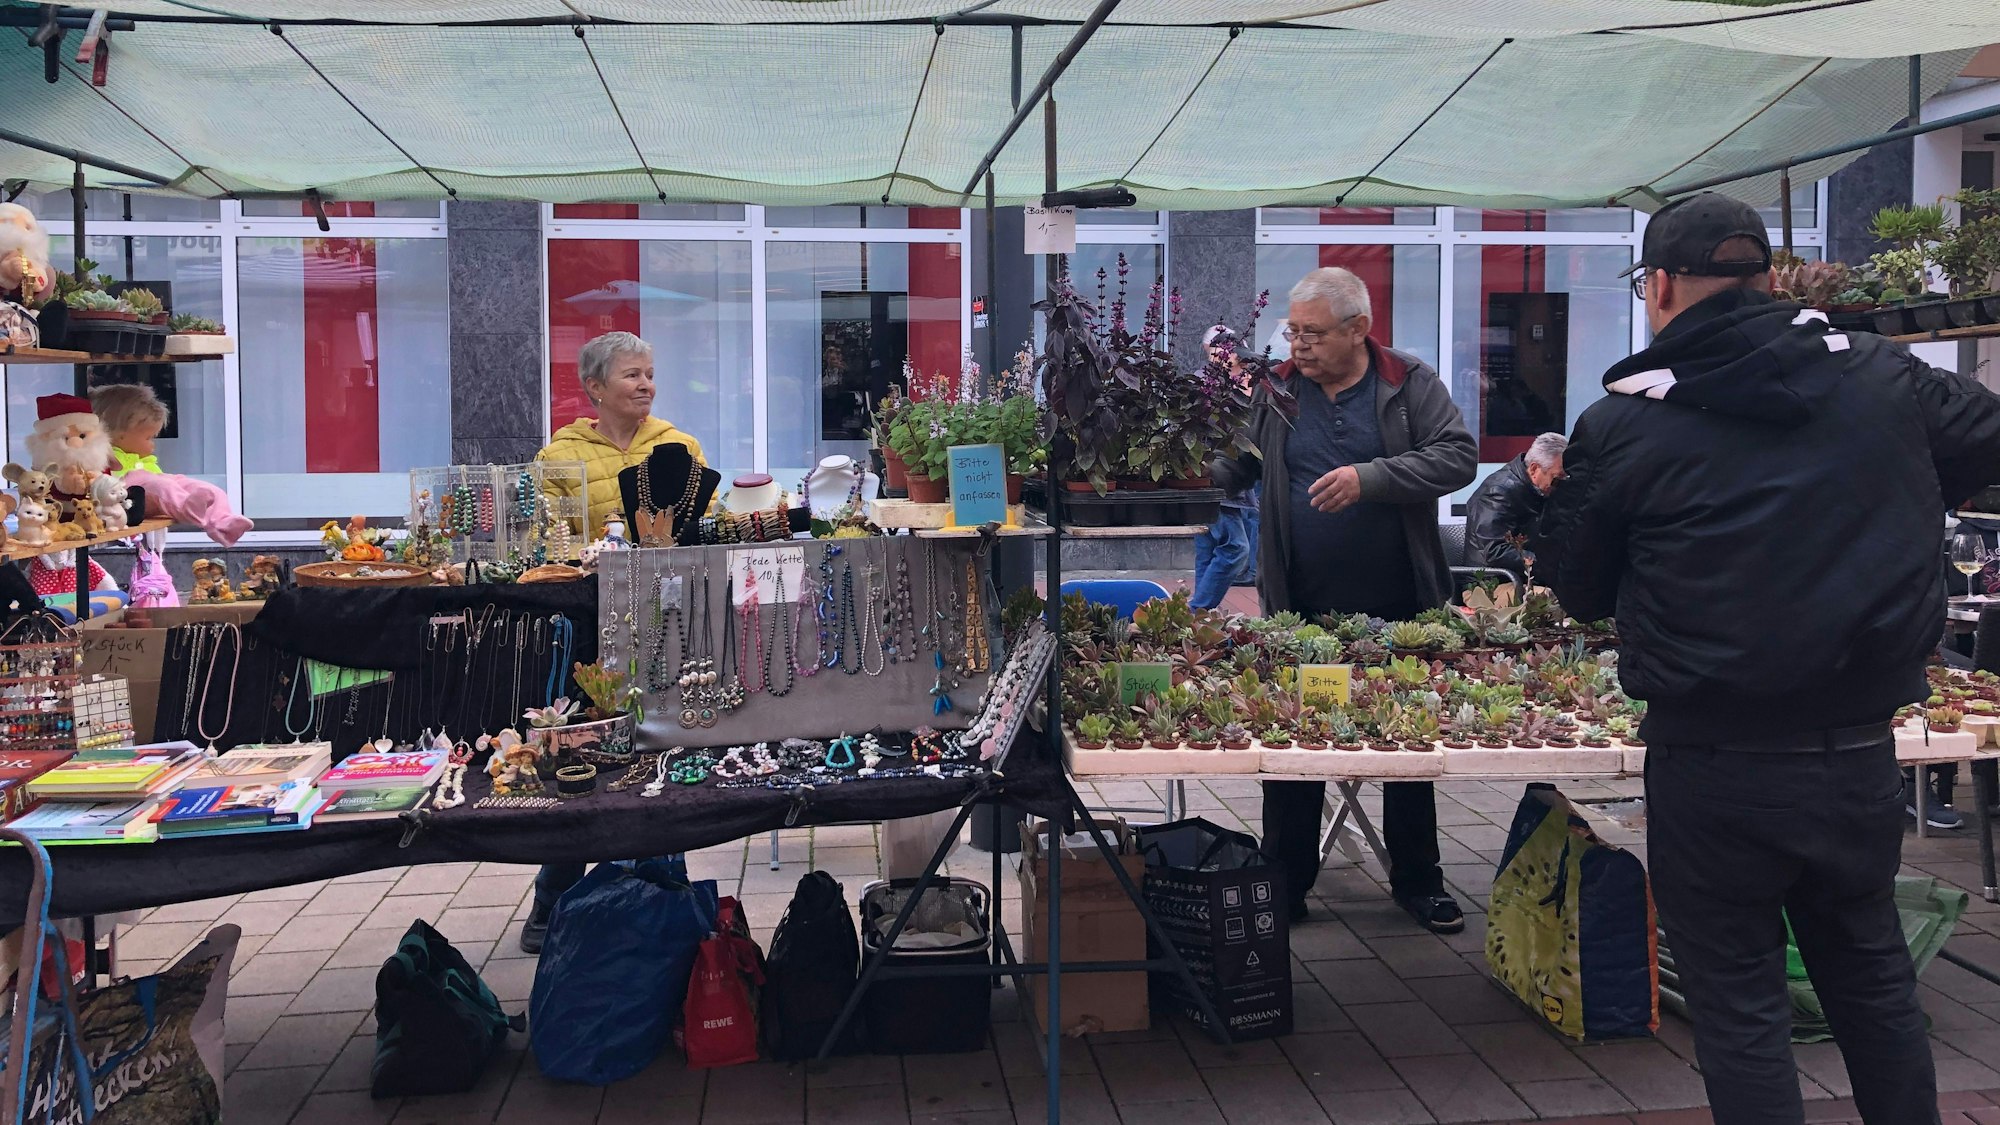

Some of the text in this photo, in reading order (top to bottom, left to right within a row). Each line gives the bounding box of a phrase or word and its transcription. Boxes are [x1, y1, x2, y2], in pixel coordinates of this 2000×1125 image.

[955, 457, 990, 469] Bitte
[965, 471, 993, 485] nicht
[959, 491, 1001, 505] anfassen
[742, 556, 770, 571] Jede
[1123, 676, 1160, 691] Stück
[1306, 676, 1343, 688] Bitte
[703, 1016, 734, 1030] REWE
[1229, 1008, 1281, 1027] ROSSMANN
